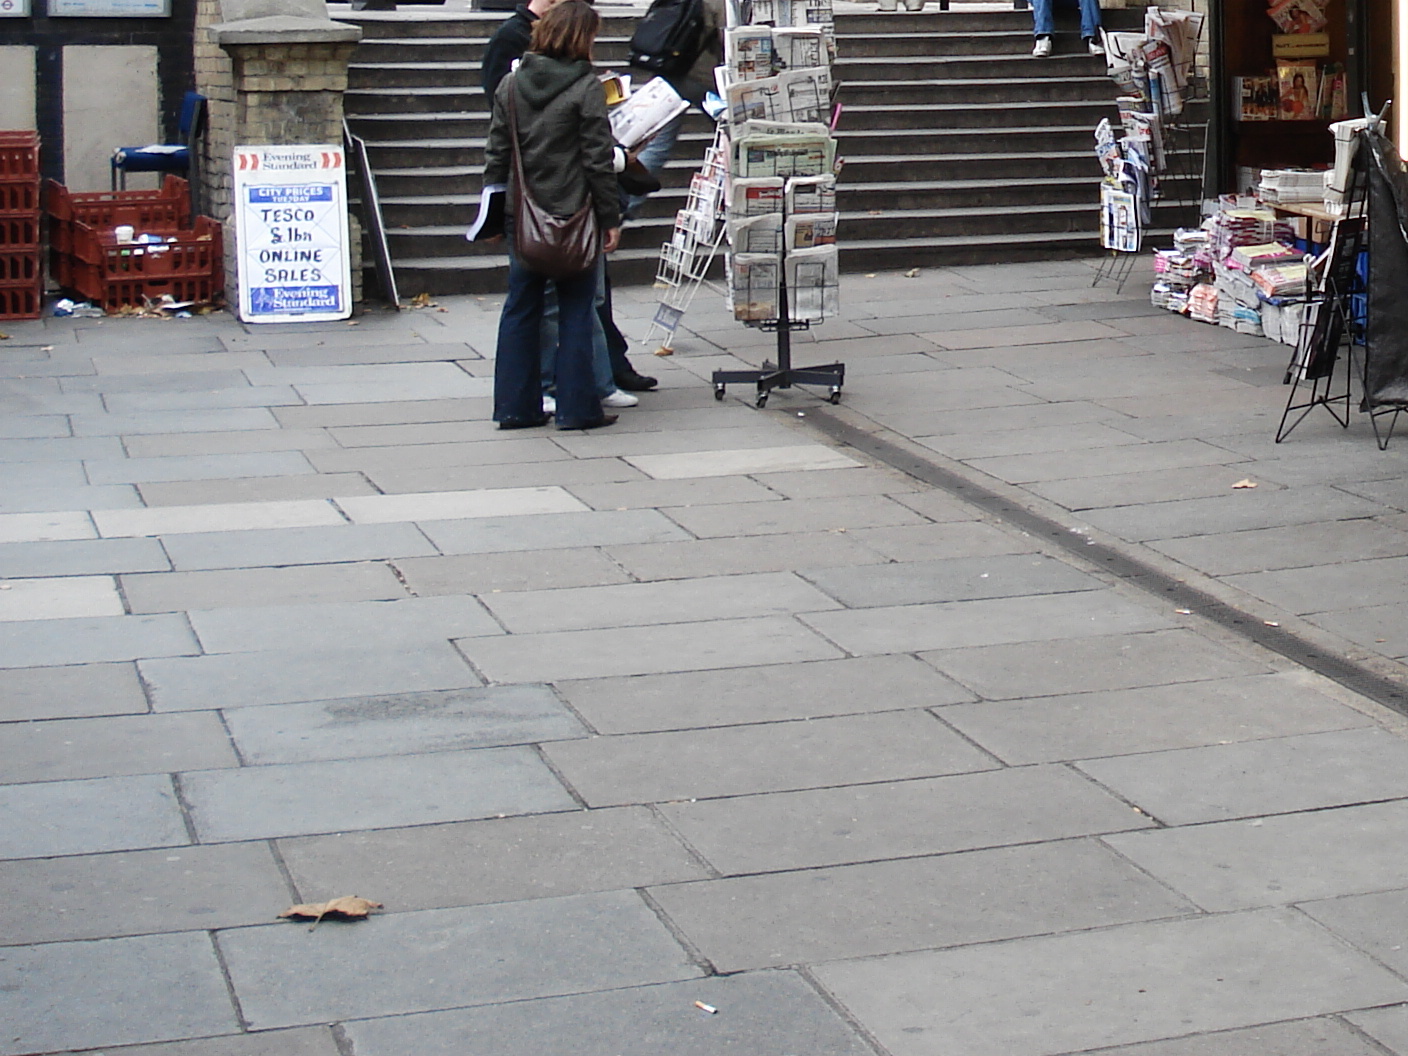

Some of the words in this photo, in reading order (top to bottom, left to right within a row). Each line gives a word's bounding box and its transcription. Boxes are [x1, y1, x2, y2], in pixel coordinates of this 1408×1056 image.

[263, 152, 311, 162] Evening
[262, 161, 317, 171] Standard
[258, 188, 282, 197] CITY
[285, 187, 324, 196] PRICES
[272, 195, 310, 203] TUESDAY
[260, 208, 315, 223] TESCO
[259, 249, 323, 263] ONLINE
[264, 267, 322, 283] SALES
[273, 287, 329, 300] Evening
[272, 296, 336, 309] Standard
